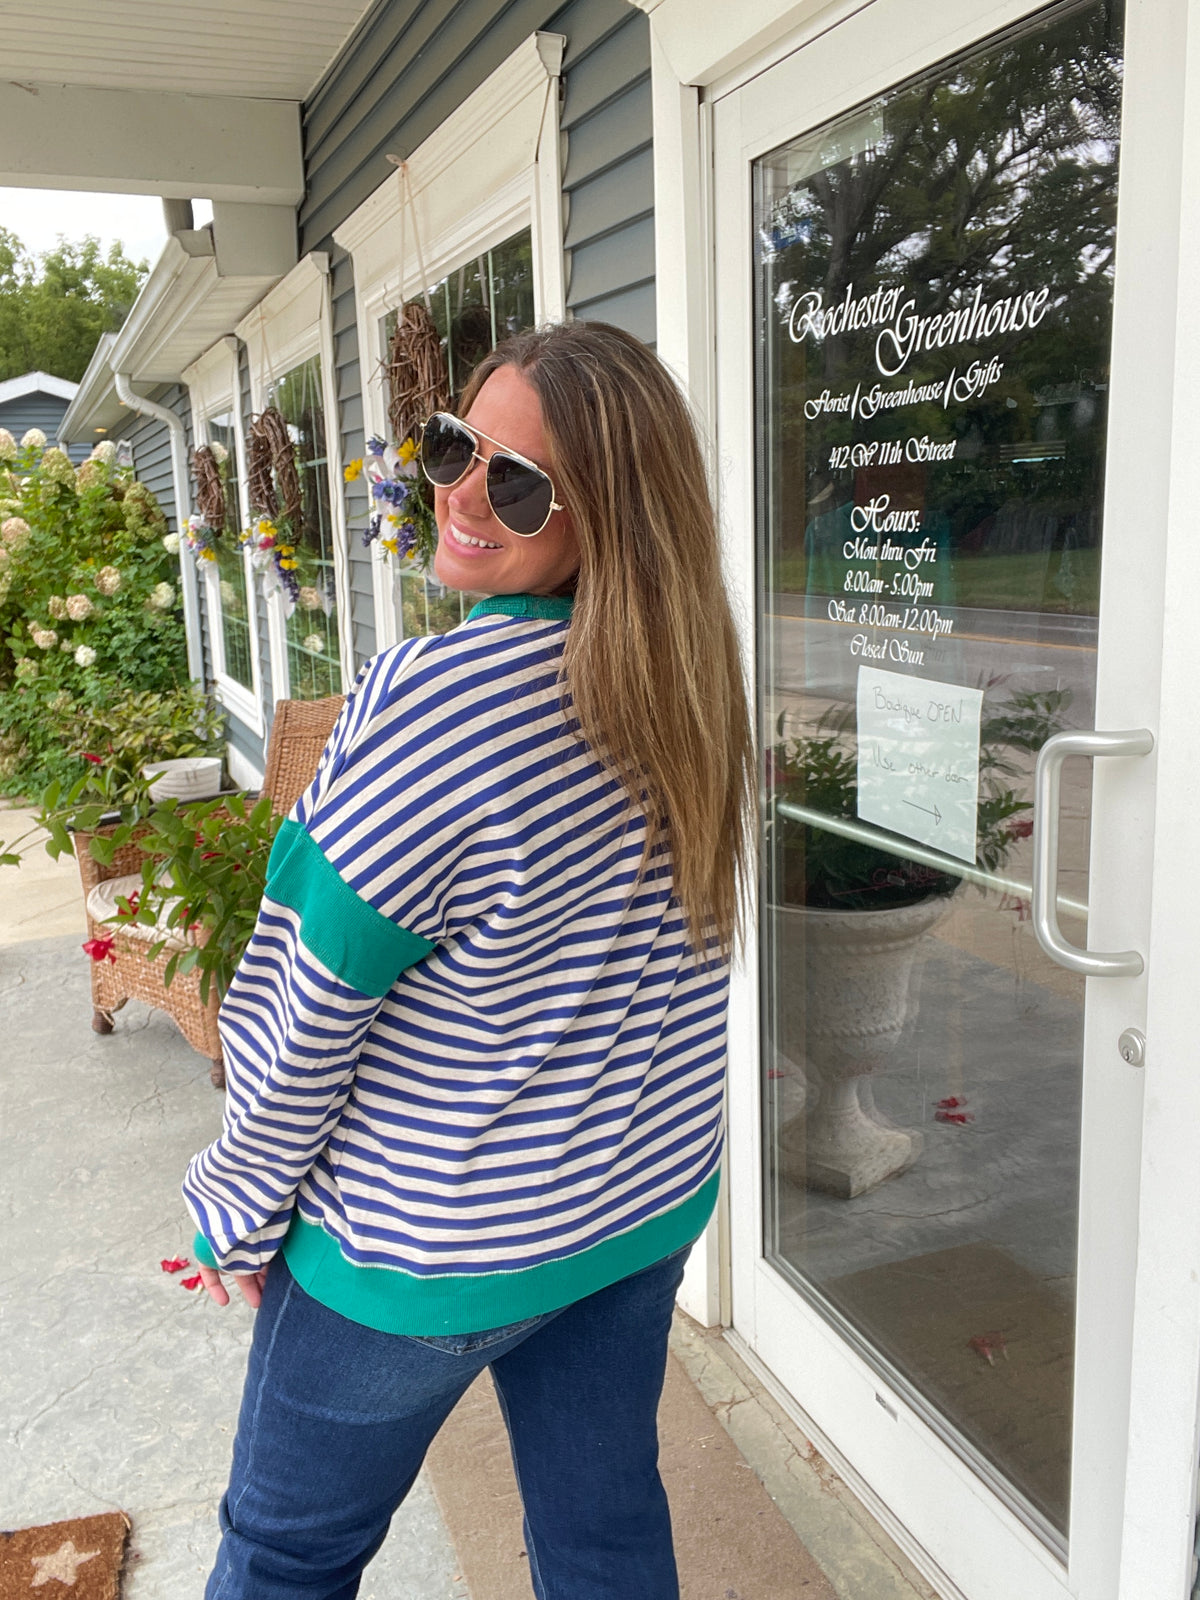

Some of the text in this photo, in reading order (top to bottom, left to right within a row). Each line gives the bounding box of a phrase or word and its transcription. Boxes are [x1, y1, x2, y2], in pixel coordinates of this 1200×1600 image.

[789, 283, 904, 343] Rochester
[875, 283, 1050, 376] Greenhouse
[859, 379, 944, 419] Greenhouse
[953, 355, 1004, 401] Gifts
[829, 435, 957, 469] 412 W. 11th Street
[850, 494, 921, 533] Hours:
[880, 538, 904, 561] thru
[844, 570, 884, 593] 8:00am
[890, 572, 935, 605] 5:00pm
[850, 633, 888, 659] Closed
[927, 699, 963, 723] OPEN
[872, 741, 896, 771] Use
[908, 762, 940, 778] other
